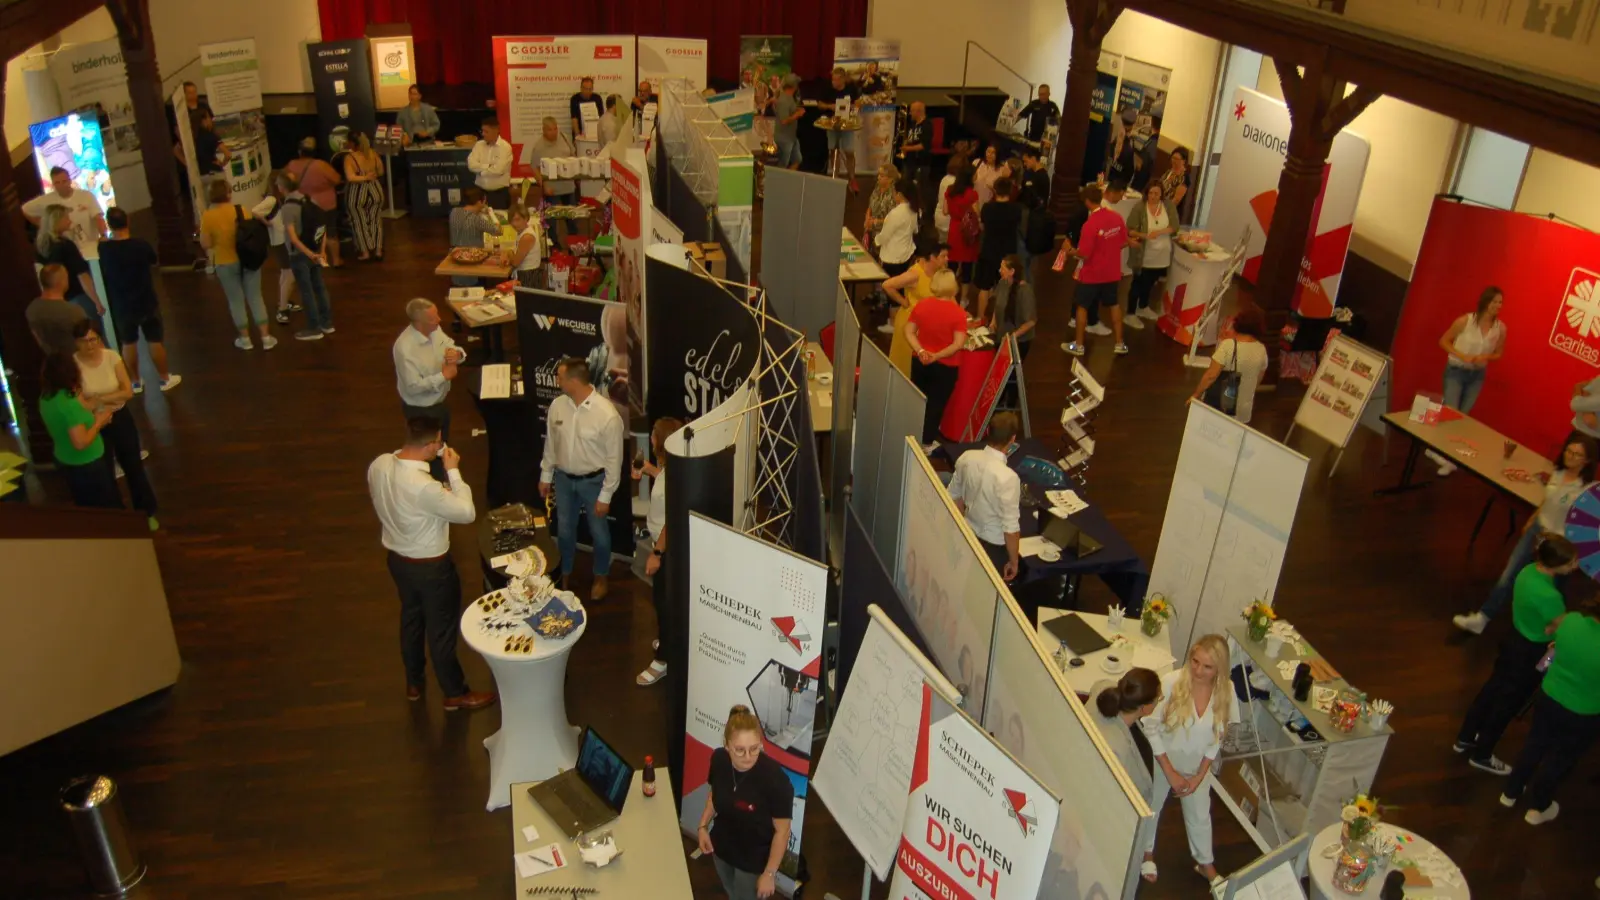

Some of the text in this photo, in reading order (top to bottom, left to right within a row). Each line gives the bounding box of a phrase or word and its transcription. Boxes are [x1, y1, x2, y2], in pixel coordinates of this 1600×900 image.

[72, 52, 123, 74] binderhol
[522, 46, 569, 54] GOSSLER
[597, 74, 623, 82] Energie
[558, 317, 596, 332] WECUBEX
[685, 330, 743, 394] edel
[1554, 333, 1599, 363] caritas
[684, 371, 730, 417] STA
[700, 584, 763, 620] SCHIEPEK
[700, 597, 763, 631] MASCHINENBAU
[727, 645, 747, 658] durch
[732, 655, 746, 666] und
[706, 721, 721, 733] 1977
[939, 743, 994, 798] MASCHINENBAU
[941, 730, 996, 787] SCHIEPEK
[925, 793, 1013, 876] WIR SUCHEN
[926, 816, 999, 900] DICH
